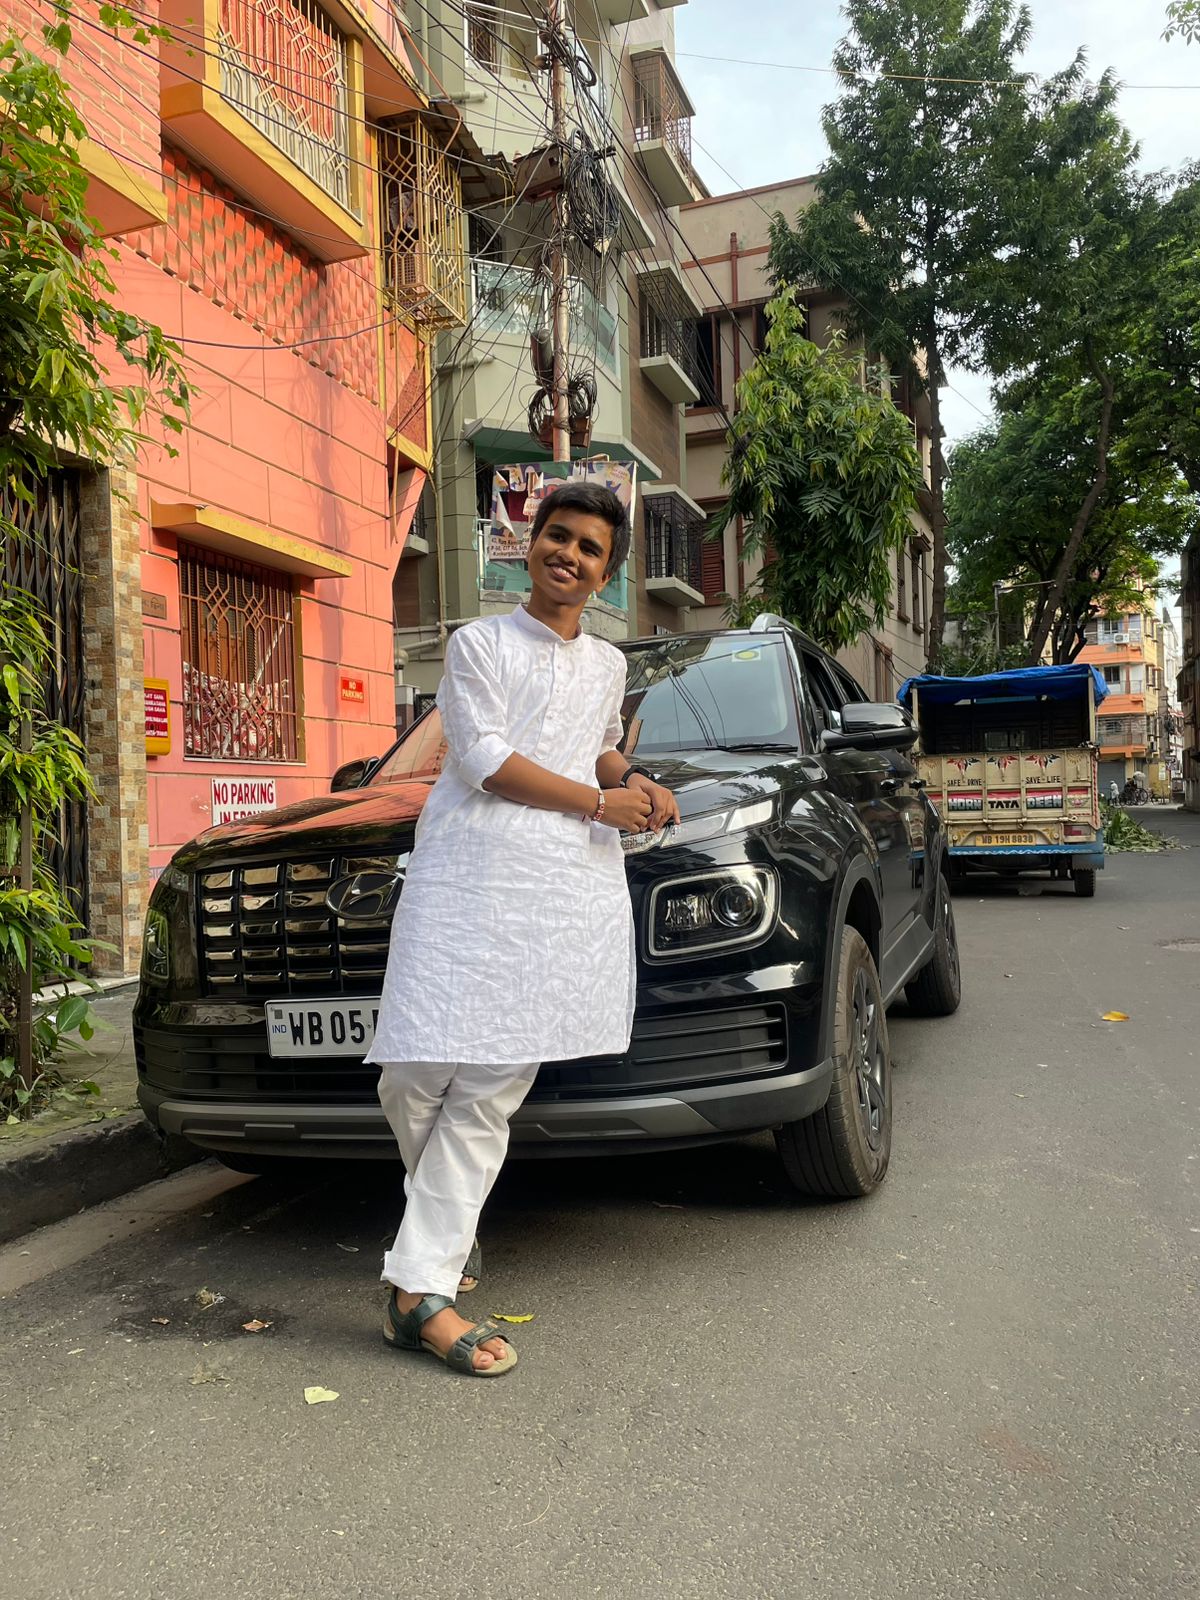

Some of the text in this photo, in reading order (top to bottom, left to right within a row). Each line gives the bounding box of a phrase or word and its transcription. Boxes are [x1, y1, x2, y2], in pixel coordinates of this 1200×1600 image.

[349, 681, 356, 690] NO
[342, 689, 363, 700] PARKING
[947, 778, 982, 787] SAFE DRIVE
[1026, 775, 1061, 784] SAVE LIFE
[213, 783, 274, 805] NO PARKING
[948, 798, 981, 810] HORN
[988, 801, 1019, 809] TATA
[272, 1025, 287, 1034] IND
